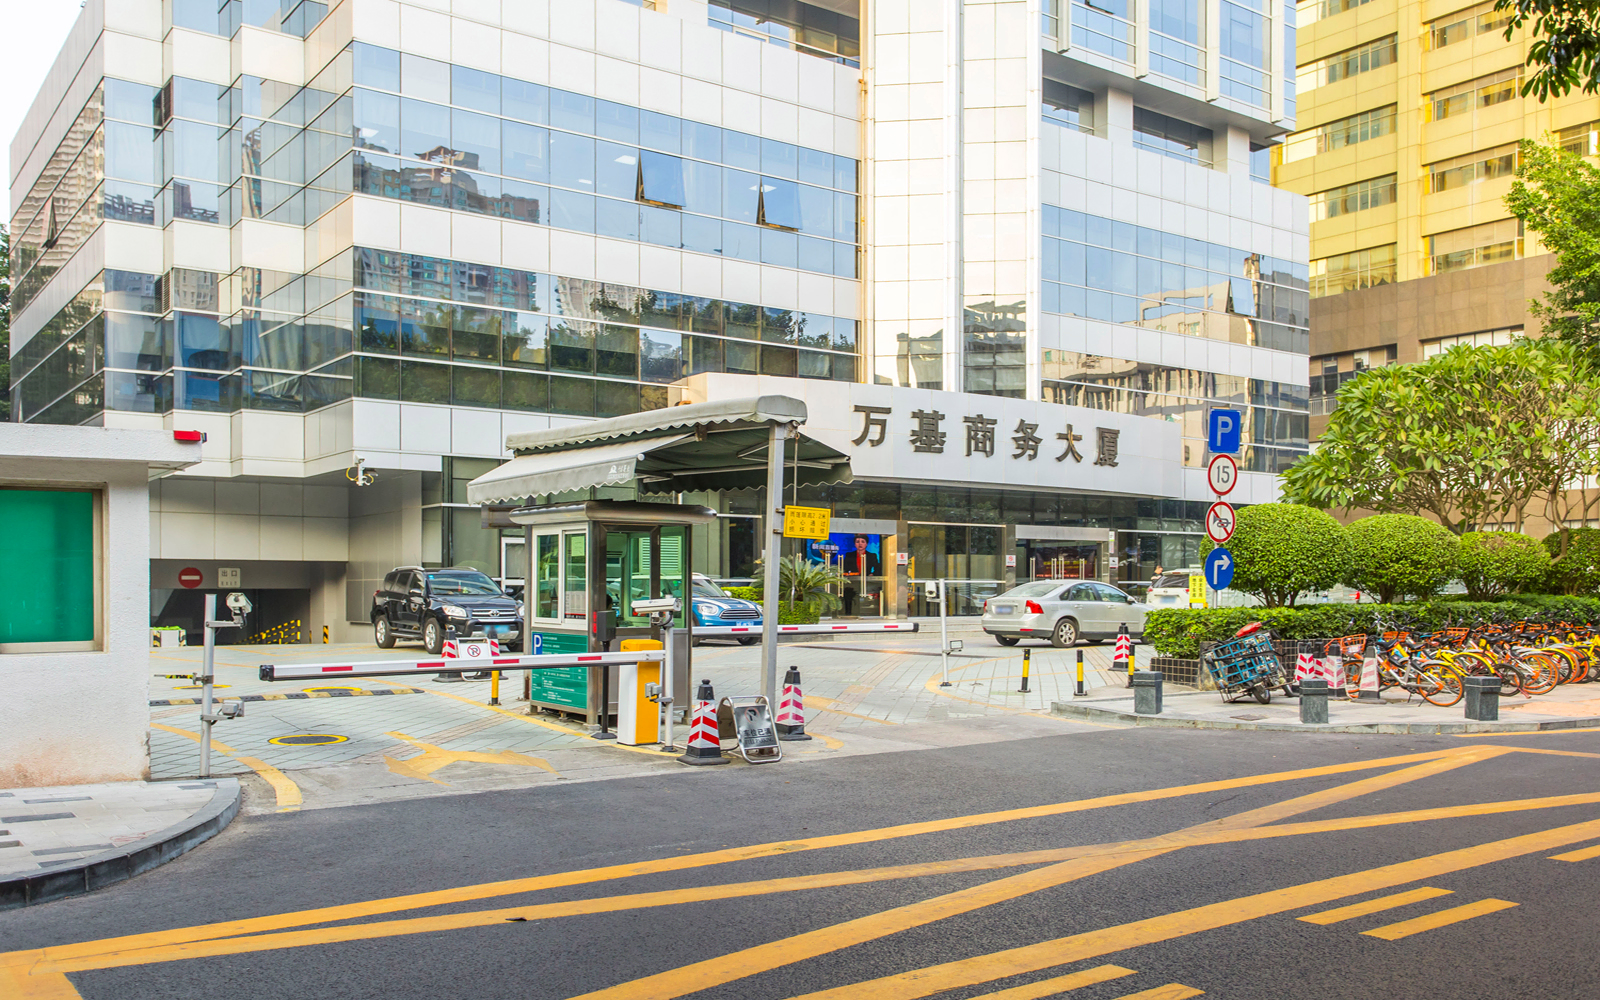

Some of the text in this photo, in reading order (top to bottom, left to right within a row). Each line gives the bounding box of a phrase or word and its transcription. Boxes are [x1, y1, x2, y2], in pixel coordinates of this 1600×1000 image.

[851, 404, 1120, 467] 万基商务大厦
[1216, 416, 1233, 447] P
[1216, 465, 1230, 484] 15
[534, 634, 542, 655] P
[744, 728, 772, 737] 车位已满
